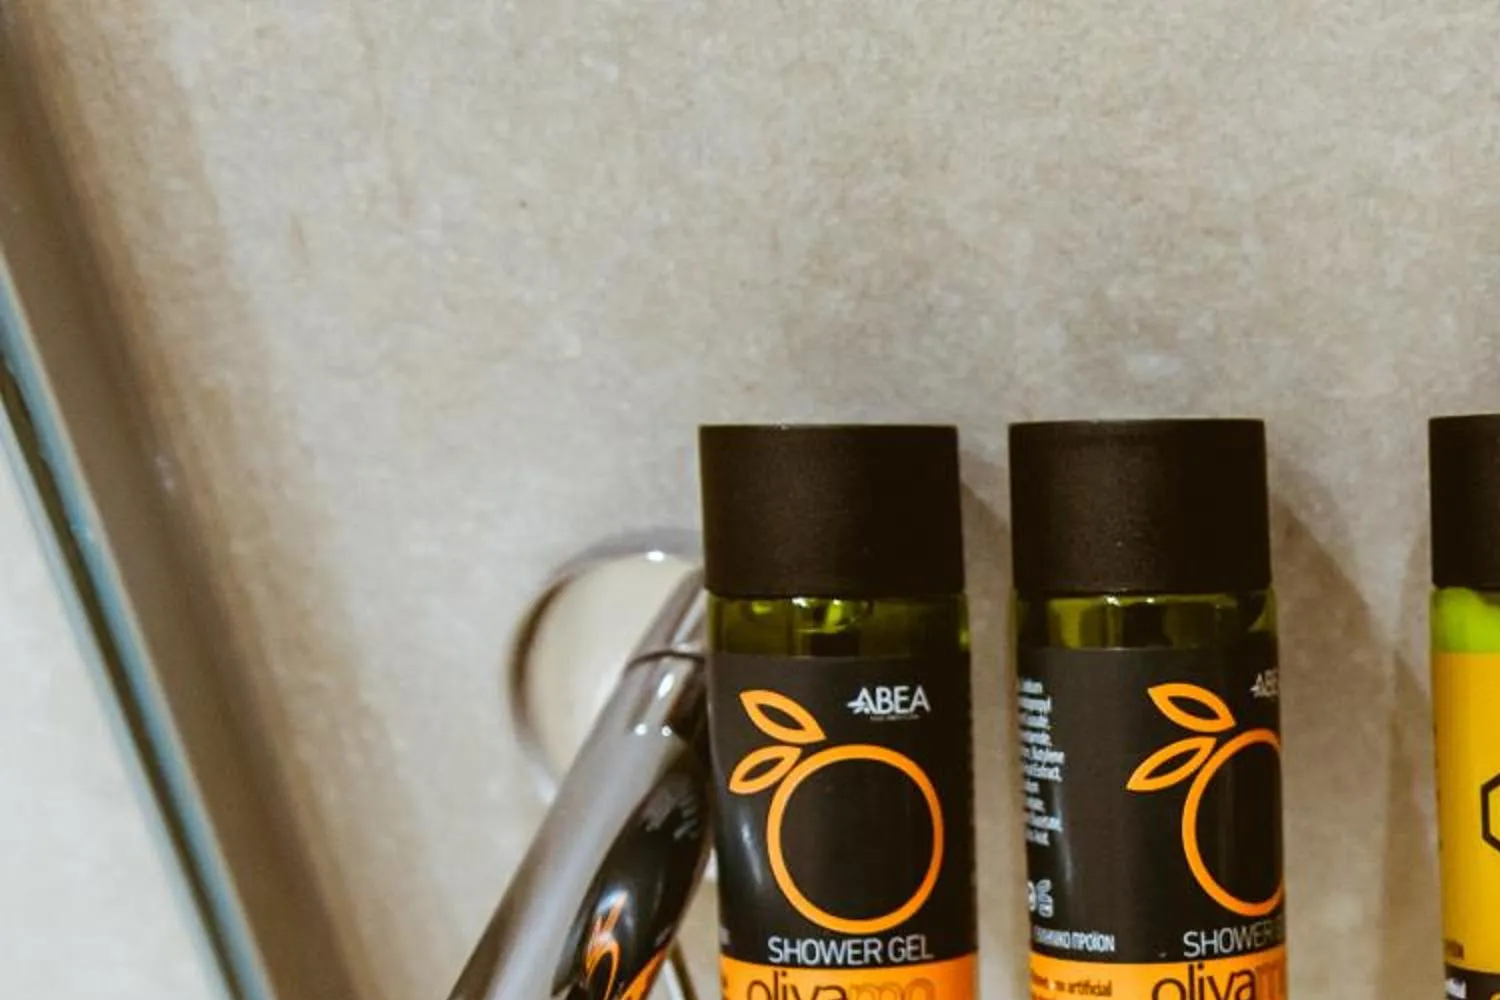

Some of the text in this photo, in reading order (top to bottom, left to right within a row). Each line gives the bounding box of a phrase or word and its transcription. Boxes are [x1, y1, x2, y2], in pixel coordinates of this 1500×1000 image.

[847, 684, 931, 715] ABEA
[767, 934, 934, 966] SHOWER GEL
